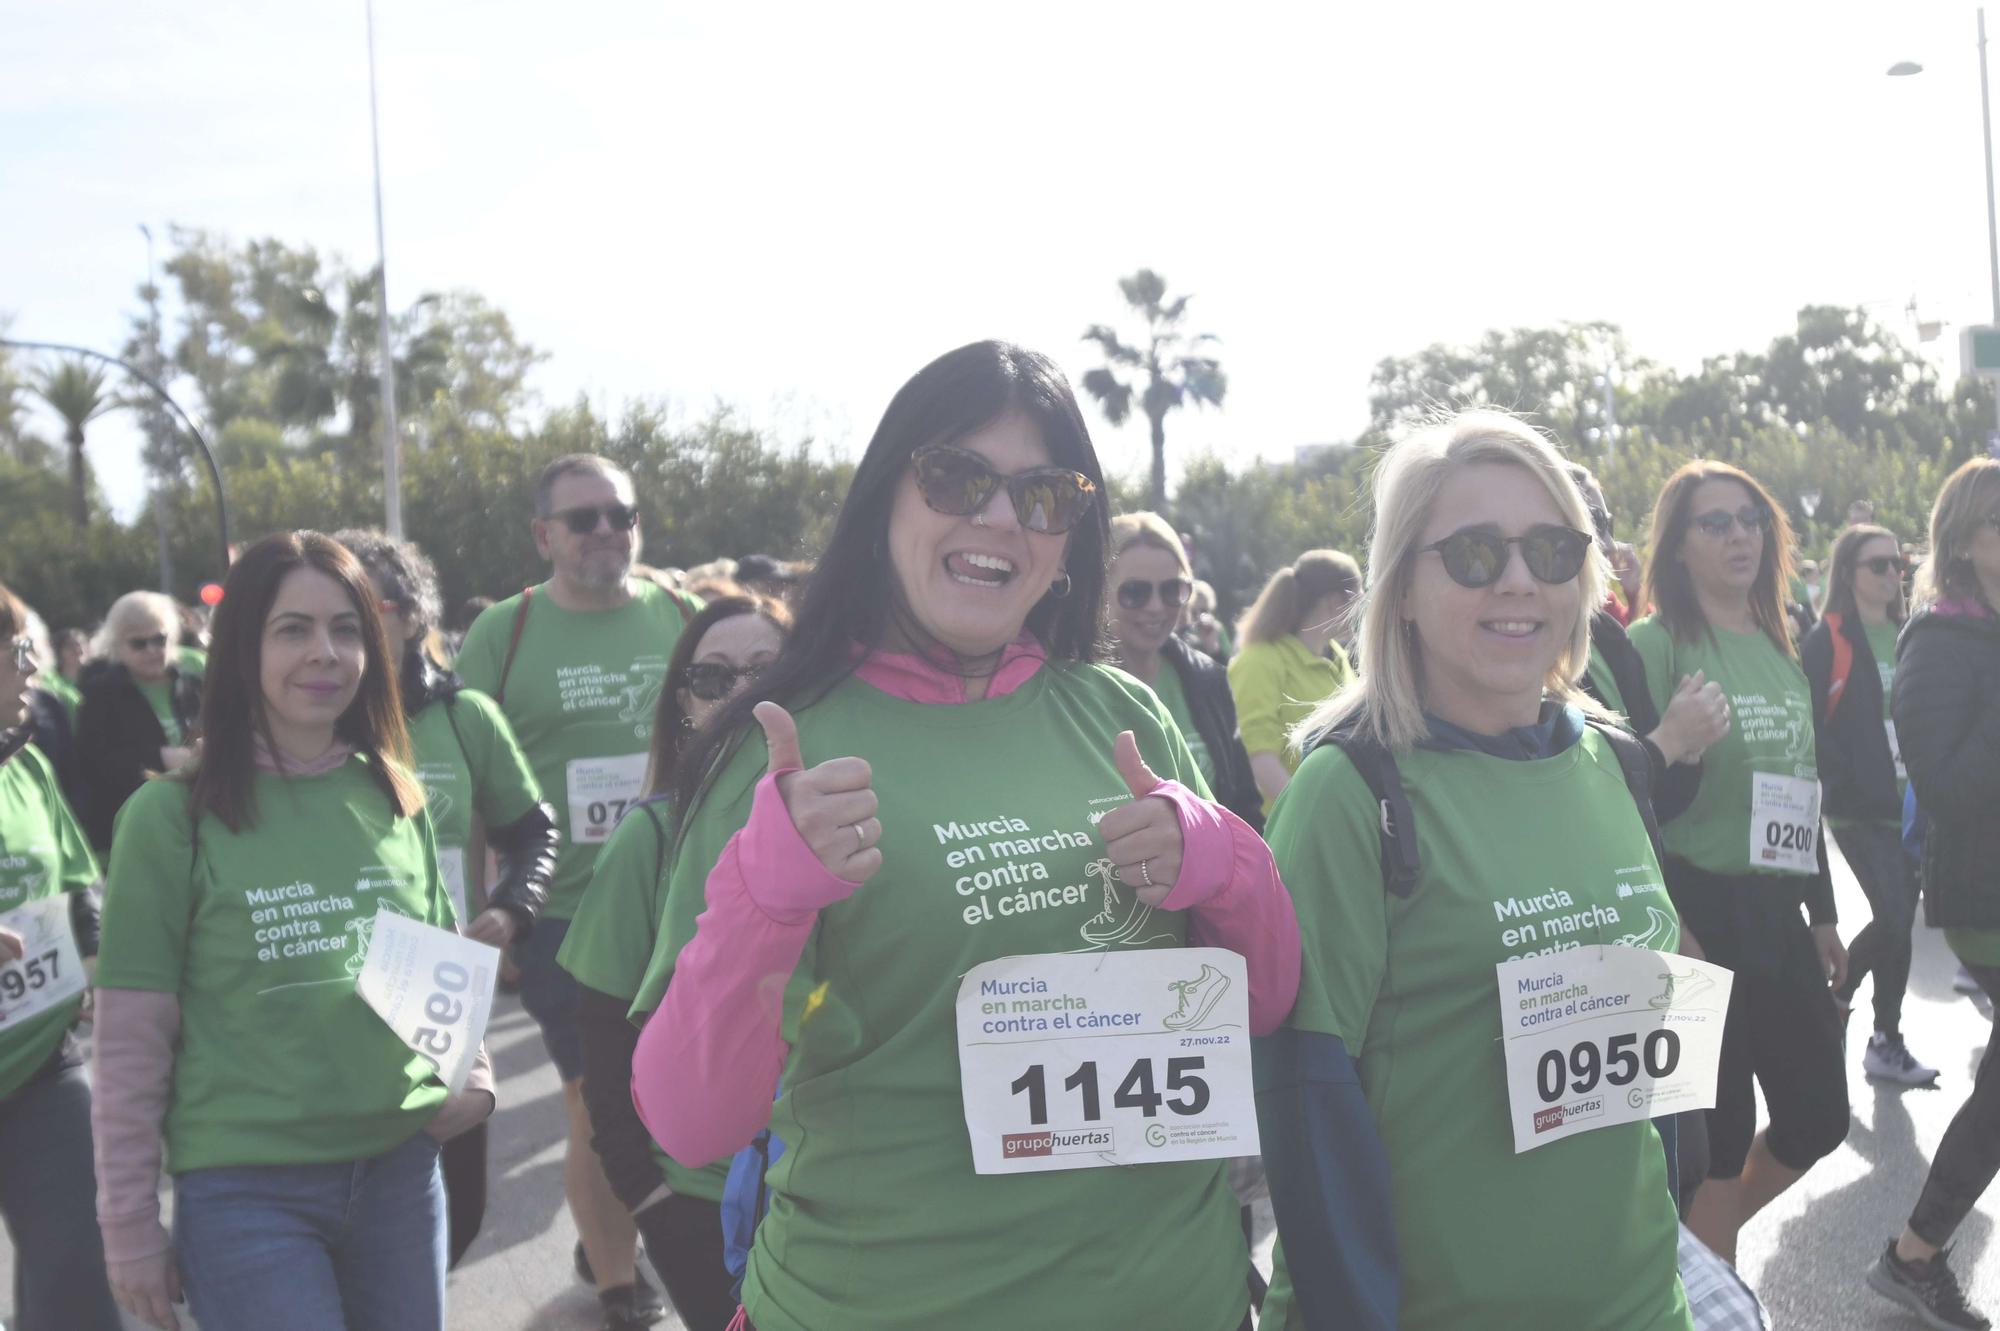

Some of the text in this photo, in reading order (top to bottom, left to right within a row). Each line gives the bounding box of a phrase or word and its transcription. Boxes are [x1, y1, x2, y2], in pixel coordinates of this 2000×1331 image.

[556, 665, 601, 678] Murcia
[559, 672, 627, 688] en marcha
[561, 686, 603, 699] contra
[1732, 694, 1767, 706] Murcia
[1741, 717, 1775, 730] contra
[588, 799, 639, 825] 07
[933, 815, 1030, 845] Murcia
[1767, 821, 1812, 852] 0200
[946, 829, 1093, 868] en marcha
[955, 861, 1049, 896] contra
[245, 881, 315, 905] Murcia
[963, 883, 1089, 925] el cáncer
[1493, 887, 1574, 922] Murcia
[251, 895, 354, 924] en marcha
[255, 919, 320, 943] contra
[1502, 904, 1620, 947] en marcha
[258, 934, 348, 961] el cáncer
[981, 977, 1048, 996] Murcia
[1518, 972, 1563, 993] Murcia
[981, 994, 1087, 1015] en marcha
[1520, 983, 1588, 1010] en marcha
[1520, 992, 1631, 1027] contra el cáncer
[982, 1011, 1141, 1033] contra el cáncer
[1660, 1014, 1706, 1022] 27.nov.22
[1180, 1036, 1230, 1047] 27.nov.22
[1537, 1029, 1681, 1103] 0950
[1011, 1056, 1210, 1125] 1145
